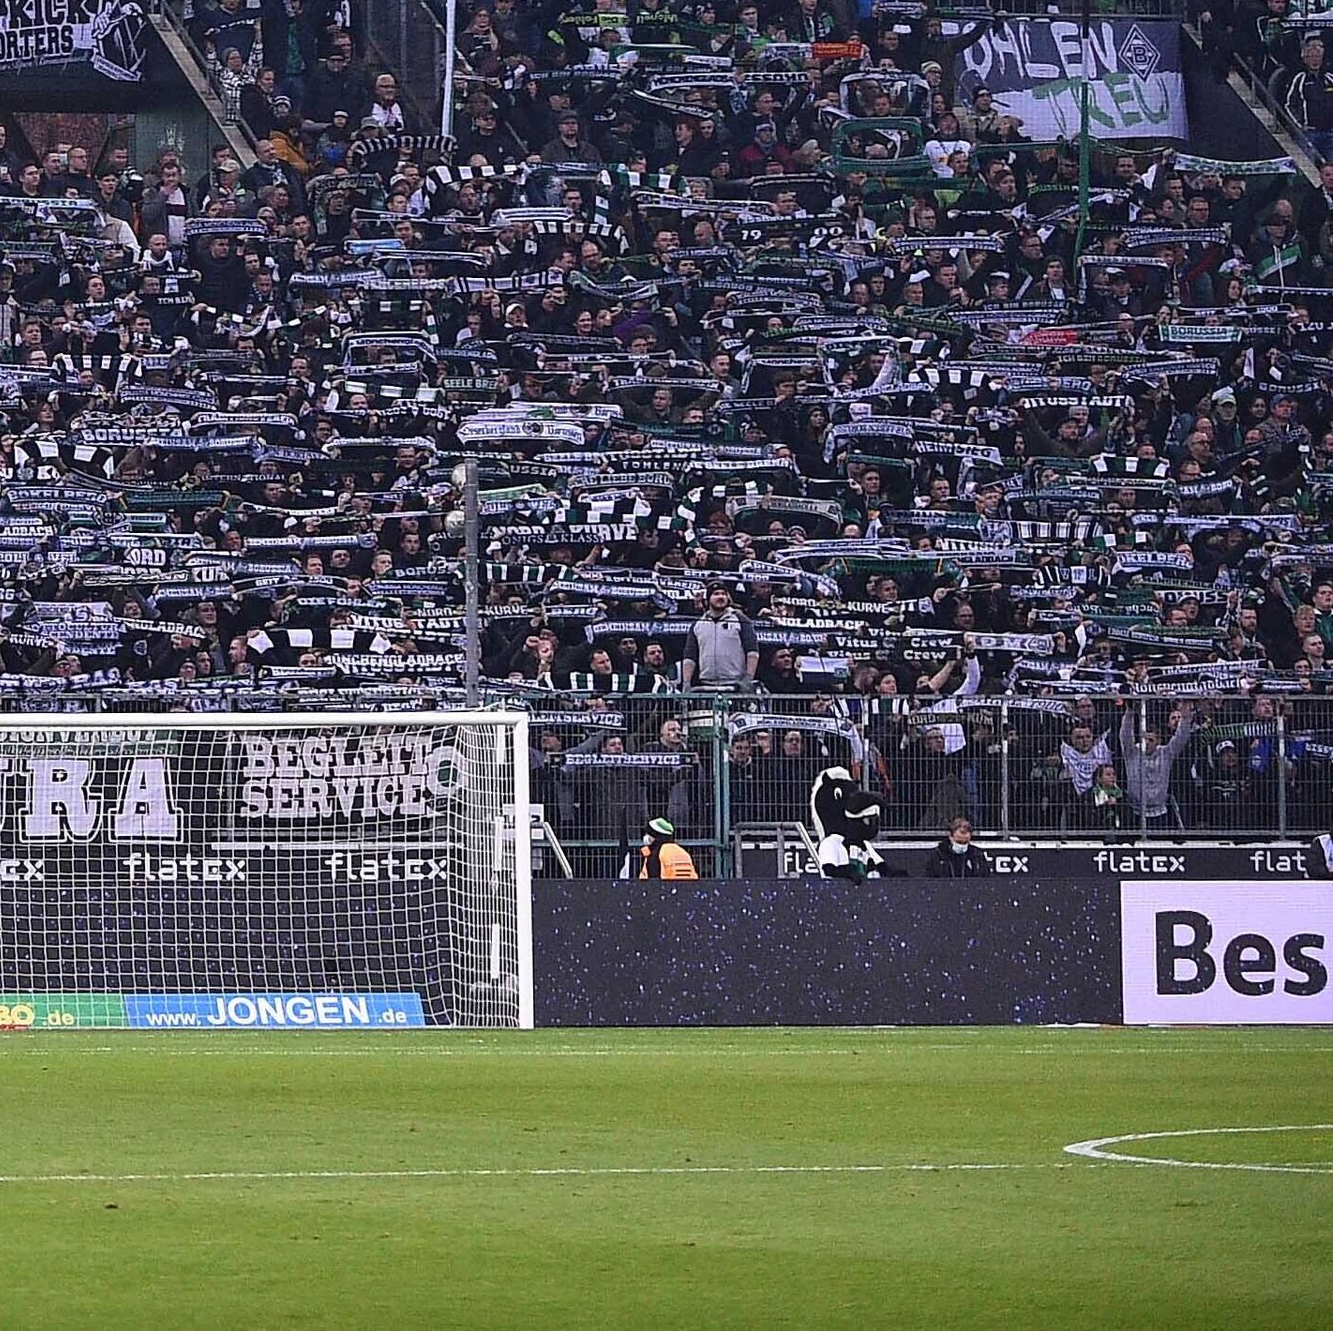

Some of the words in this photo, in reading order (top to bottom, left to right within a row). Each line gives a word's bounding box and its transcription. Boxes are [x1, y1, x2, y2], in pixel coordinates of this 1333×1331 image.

[741, 229, 762, 241] 19
[1170, 326, 1228, 338] BORUSSIA
[443, 379, 475, 390] SEELE
[81, 426, 184, 443] BORUSSIA
[297, 597, 326, 607] DIE
[332, 598, 387, 608] FOHLEN
[484, 604, 528, 616] KURVE
[782, 596, 817, 609] NORD
[847, 601, 889, 615] KURVE
[8, 634, 51, 648] KURVE
[835, 636, 878, 649] Vitus
[910, 636, 954, 649] Crew
[902, 649, 947, 662] Crew
[243, 735, 432, 778] BEGLEIT
[565, 753, 680, 766] BEGLEITSERVICE
[240, 775, 428, 819] SERVICE
[123, 851, 246, 881] flatex
[325, 851, 447, 881] flatex
[1093, 849, 1185, 873] flatex
[1250, 848, 1307, 872] flat
[1155, 910, 1327, 997] Bes
[41, 1010, 75, 1028] .de
[146, 1011, 201, 1027] www.
[207, 997, 368, 1025] JONGEN
[377, 1008, 407, 1024] .de
